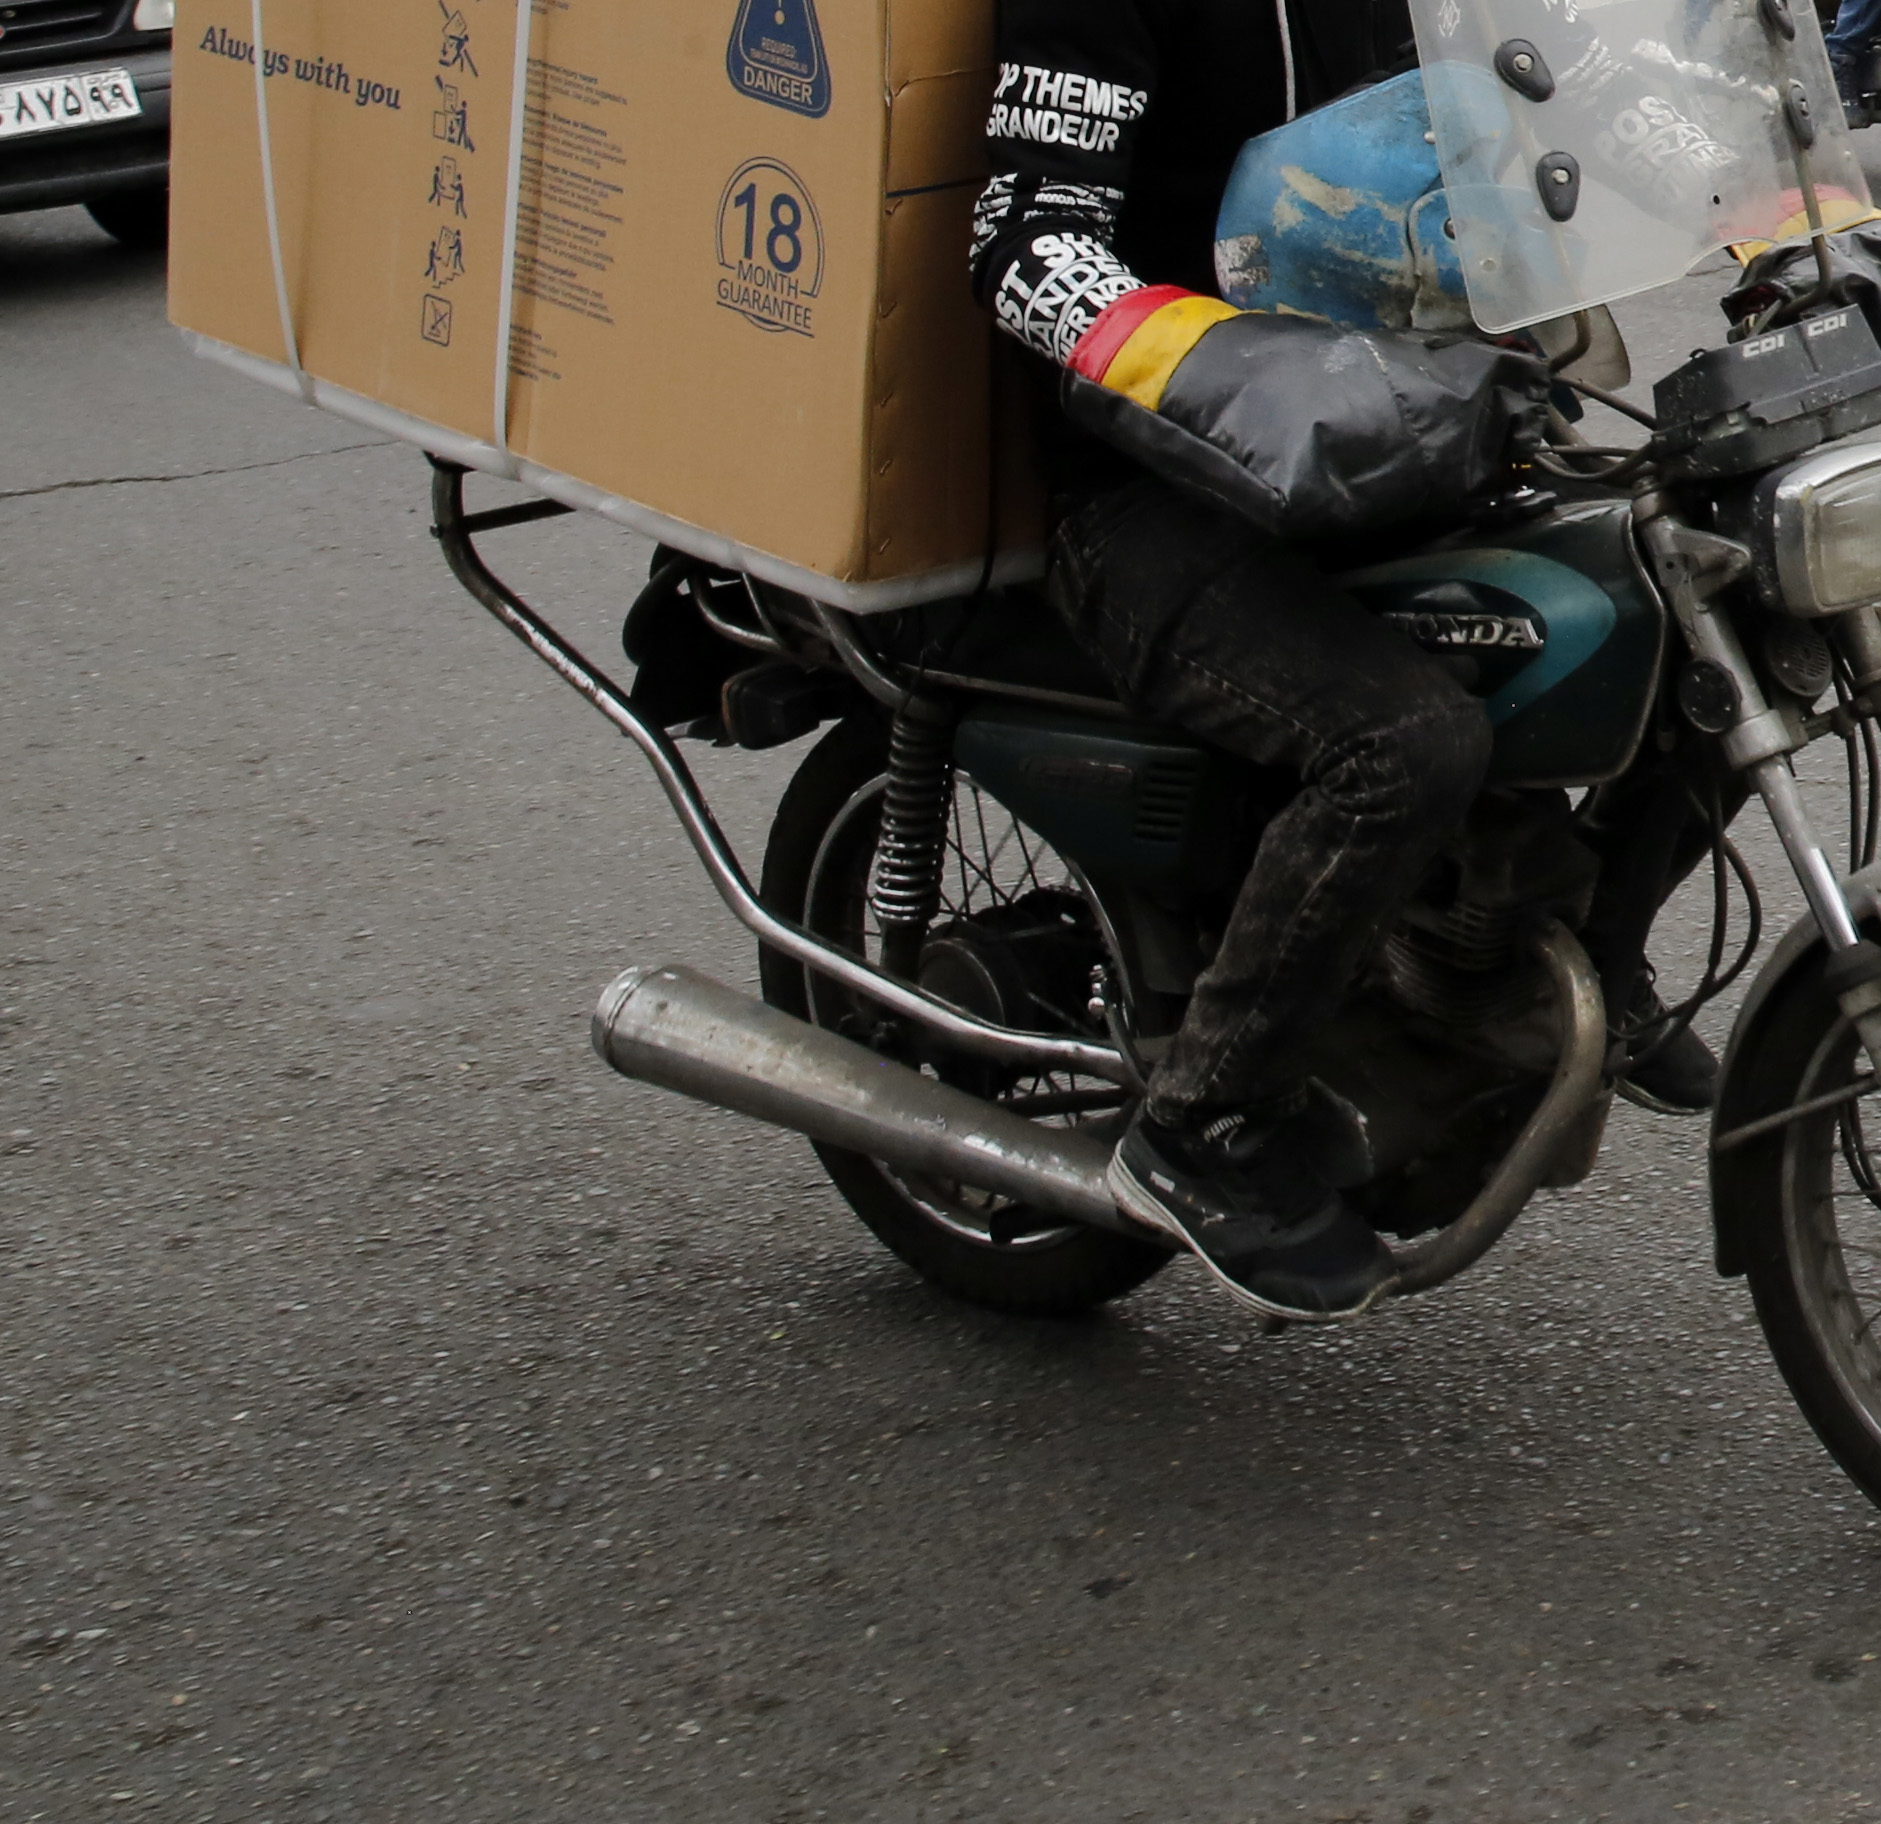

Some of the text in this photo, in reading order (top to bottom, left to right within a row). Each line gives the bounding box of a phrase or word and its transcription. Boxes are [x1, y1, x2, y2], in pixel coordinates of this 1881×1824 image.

[294, 55, 351, 94] with
[354, 76, 401, 112] you
[743, 65, 813, 106] DANGER
[1022, 64, 1148, 122] THEMES
[986, 102, 1120, 153] GRANDEUR
[732, 181, 804, 274] 18
[715, 277, 813, 331] GUARANTEE
[737, 262, 801, 298] MONTH
[1743, 334, 1785, 358] CDI
[1806, 313, 1848, 337] CDI
